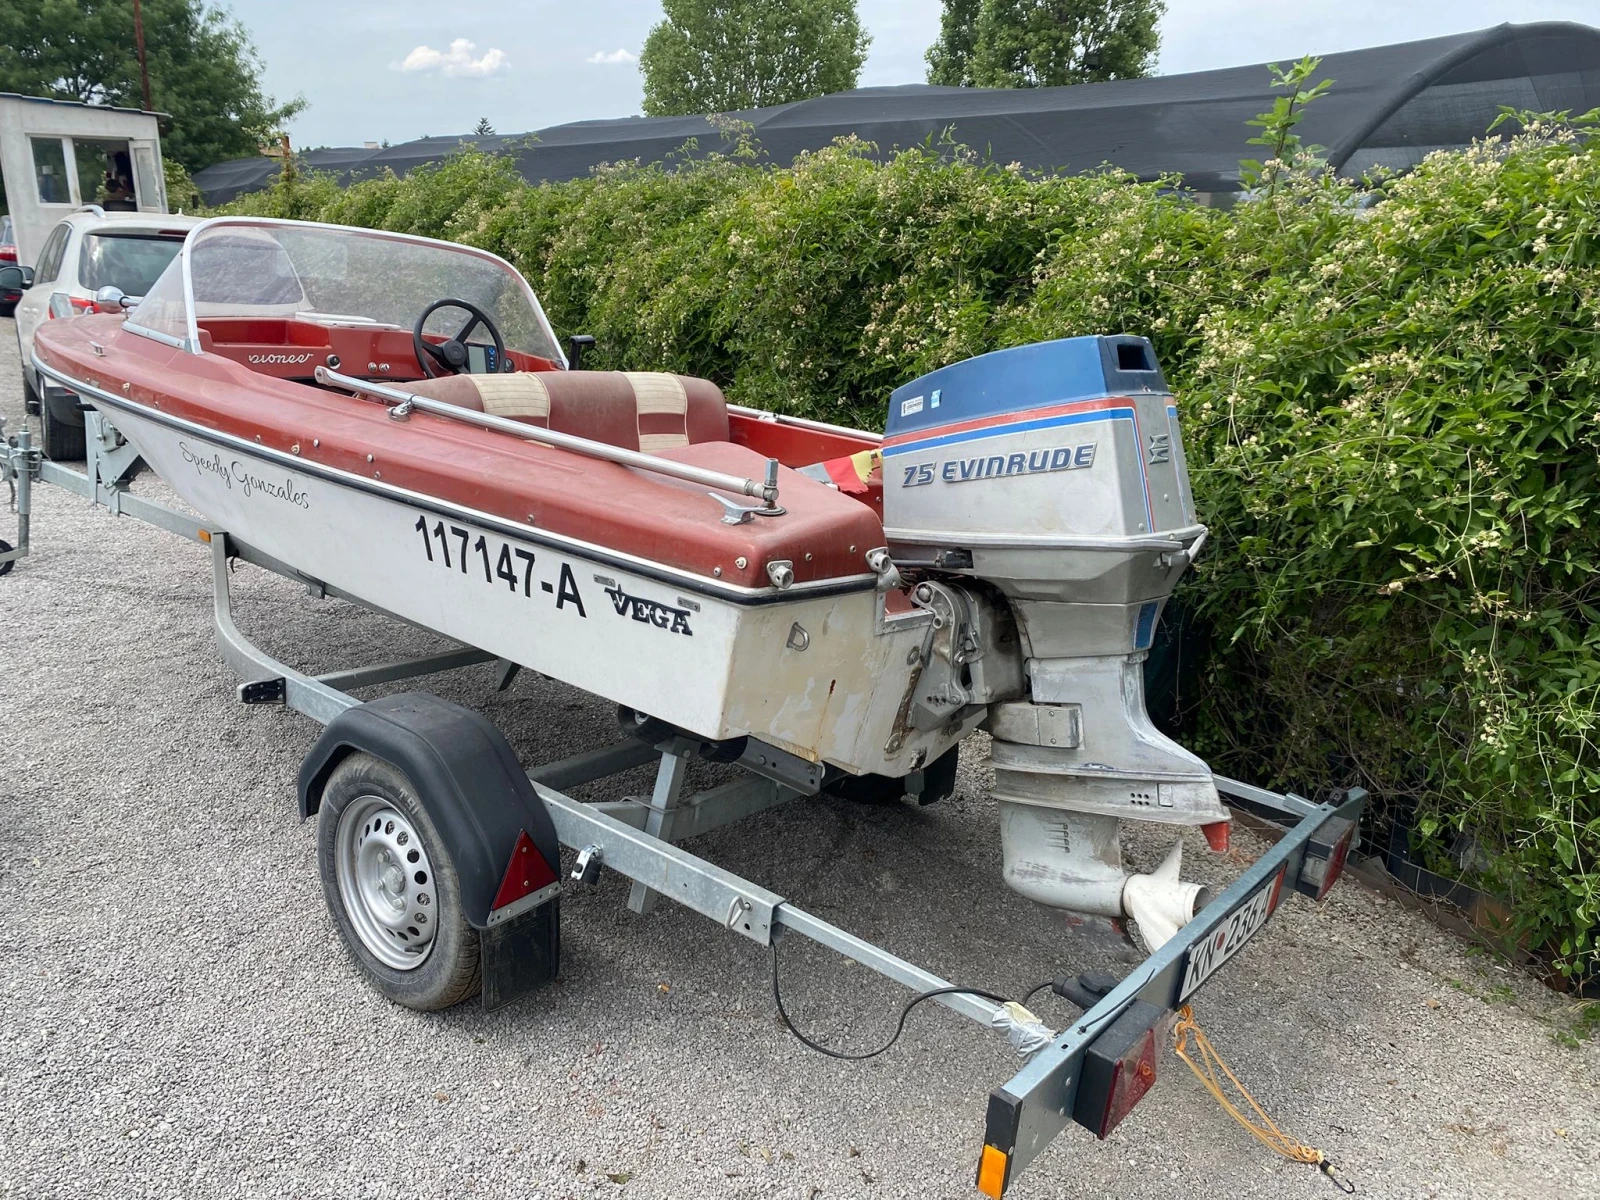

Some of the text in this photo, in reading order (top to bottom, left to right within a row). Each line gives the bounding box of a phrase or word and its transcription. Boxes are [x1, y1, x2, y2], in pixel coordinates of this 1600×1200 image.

[179, 441, 309, 509] Speedy Gonzales
[902, 442, 1099, 488] 75 EVINRUDE
[415, 515, 587, 619] 117147-A
[604, 584, 693, 636] VEGA
